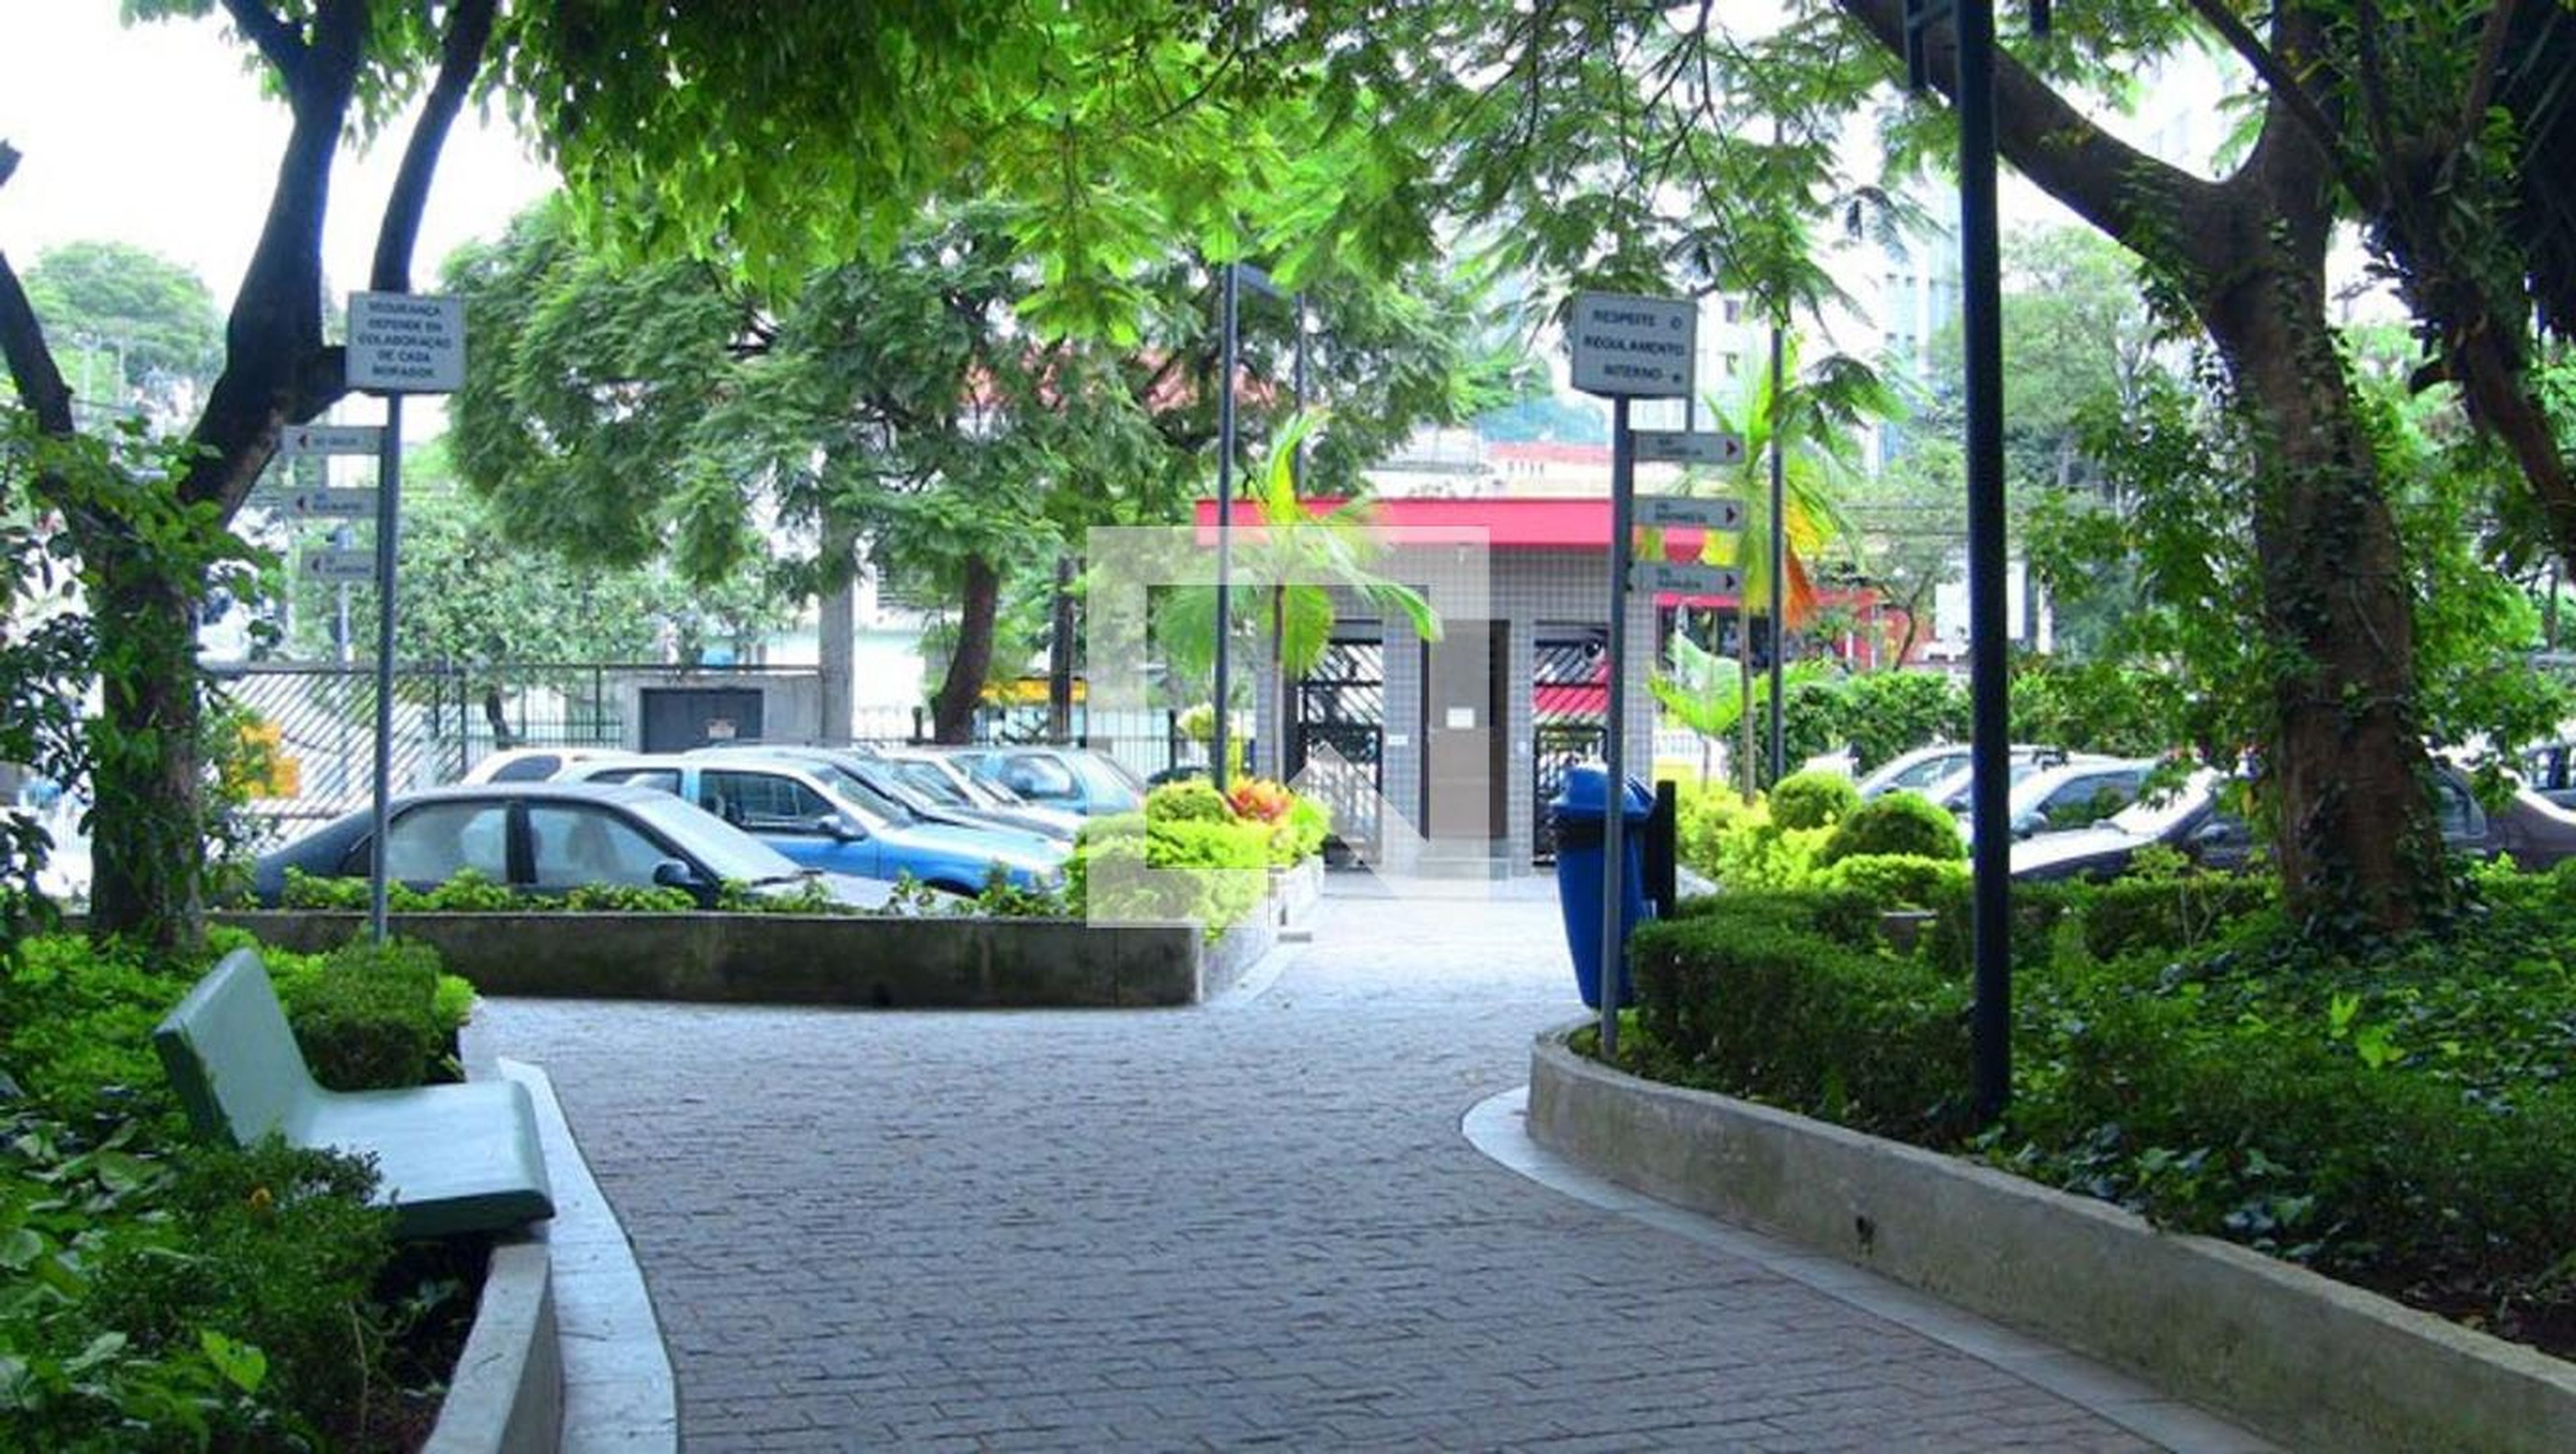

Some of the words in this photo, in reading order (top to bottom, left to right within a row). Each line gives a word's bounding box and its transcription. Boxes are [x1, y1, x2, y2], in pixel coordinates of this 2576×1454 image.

[1593, 309, 1656, 327] RESPEITE
[1670, 315, 1682, 330] O
[1584, 335, 1684, 356] REGULAMENTO
[1604, 364, 1663, 380] INTERNO
